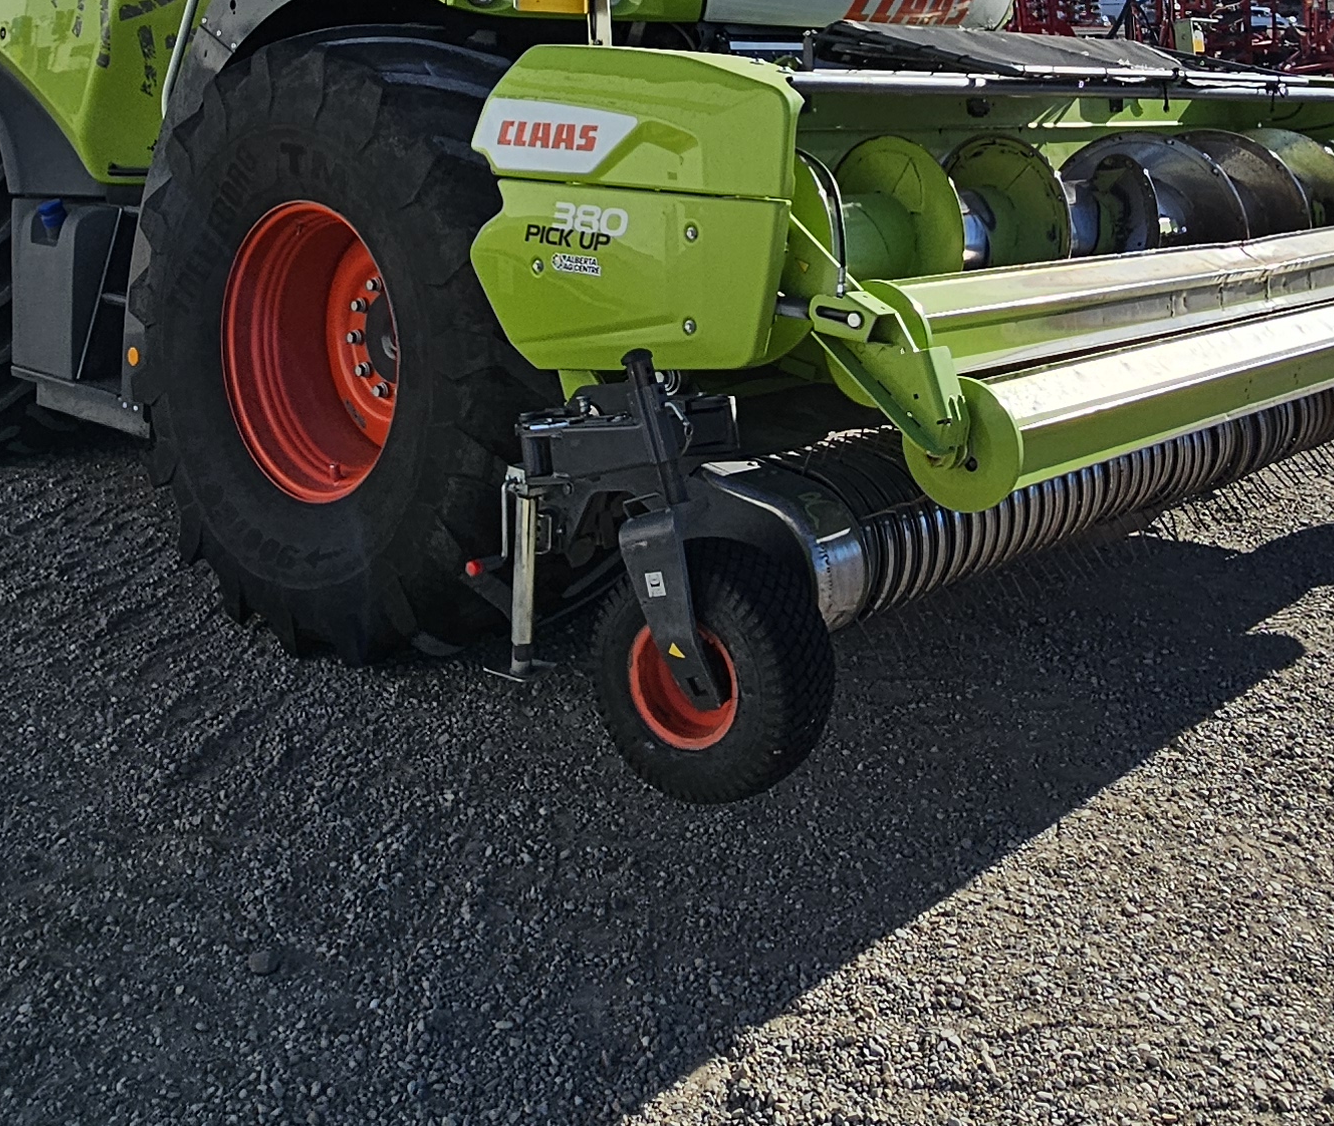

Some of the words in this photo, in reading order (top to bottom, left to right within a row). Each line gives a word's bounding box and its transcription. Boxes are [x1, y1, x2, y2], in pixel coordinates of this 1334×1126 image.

[497, 120, 599, 152] CLAAS
[551, 201, 629, 237] 380
[525, 224, 574, 248] PICK
[579, 231, 611, 251] UP
[566, 255, 597, 265] ALBERTA
